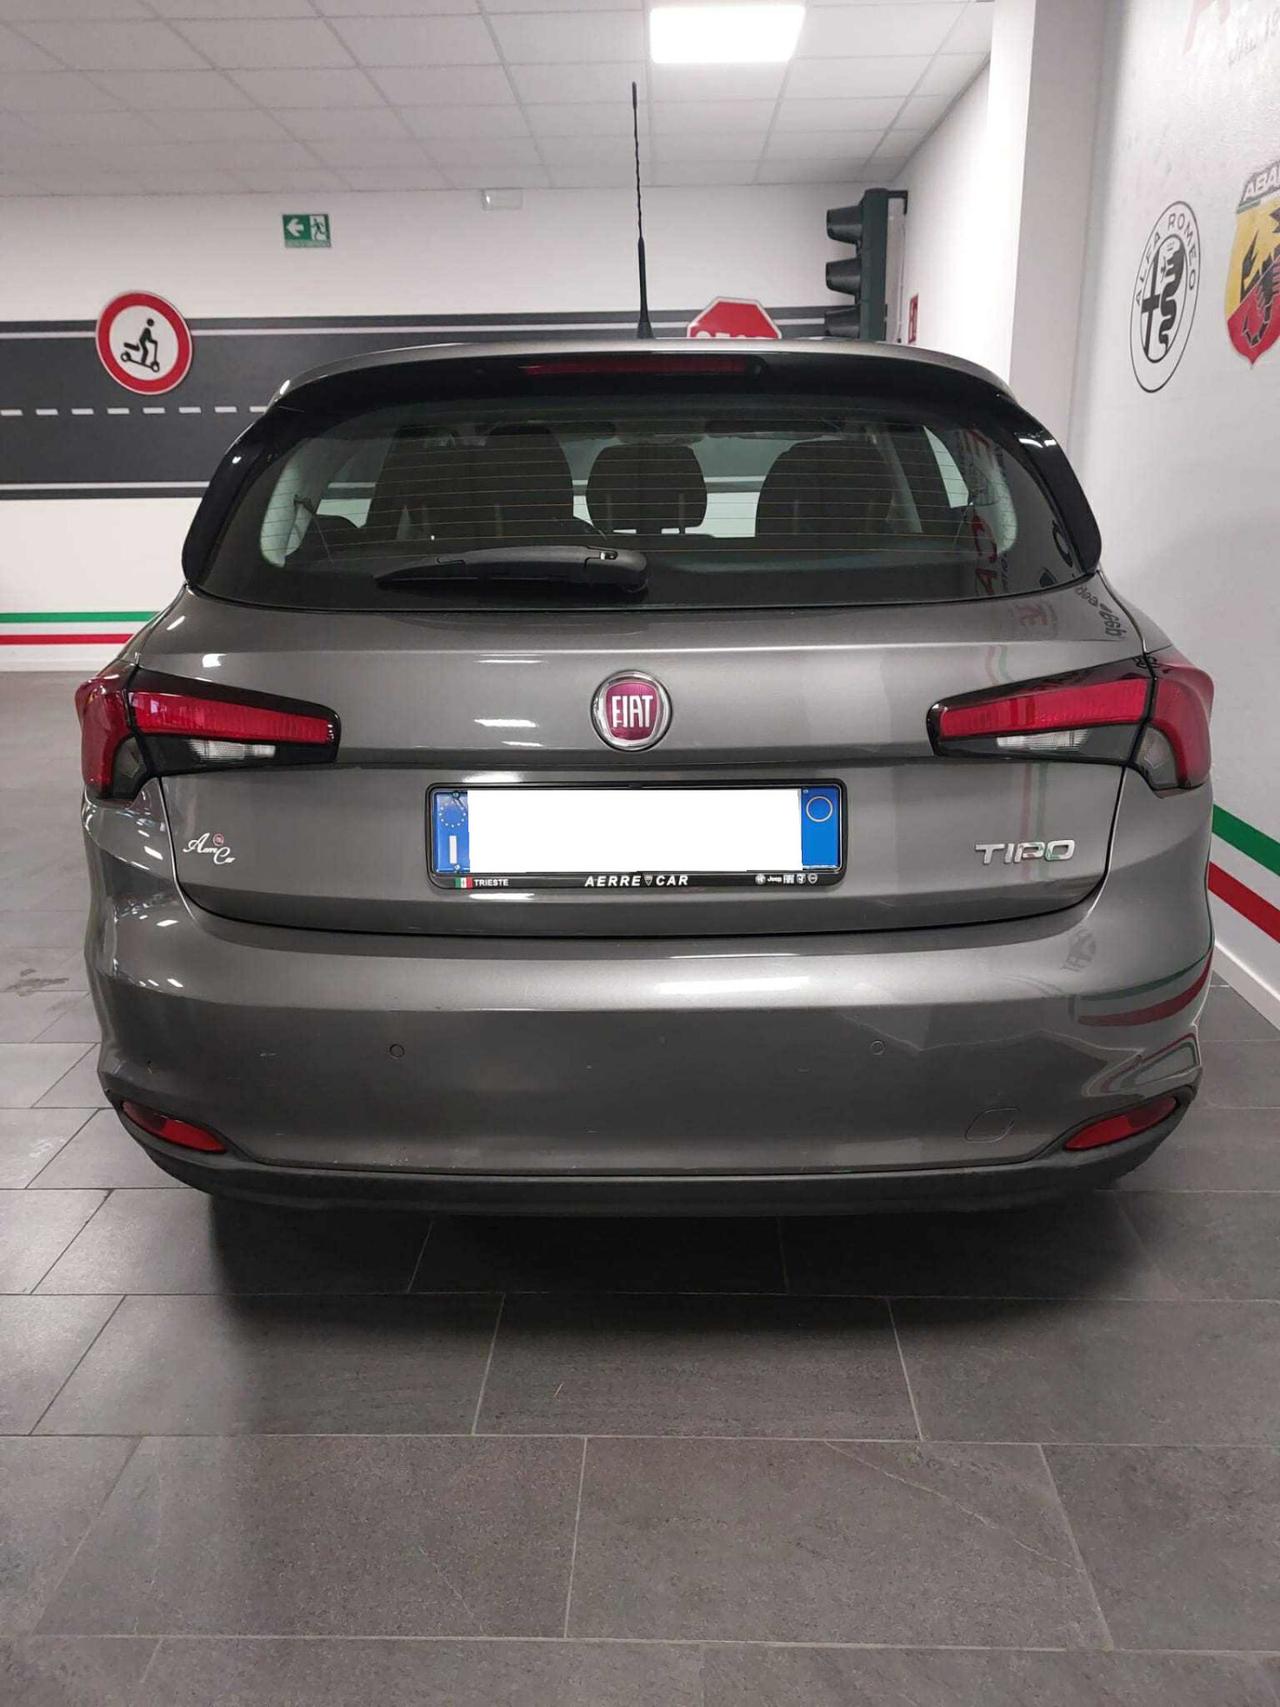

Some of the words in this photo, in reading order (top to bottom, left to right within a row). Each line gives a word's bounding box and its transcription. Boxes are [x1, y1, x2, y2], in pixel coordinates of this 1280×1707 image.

[1243, 164, 1280, 201] ABA
[1168, 212, 1198, 291] ROMEO
[611, 694, 654, 728] FIAT
[975, 839, 1075, 865] TIPO
[473, 878, 509, 887] TRIESTE
[584, 875, 642, 887] AERRE
[655, 875, 688, 887] CAR
